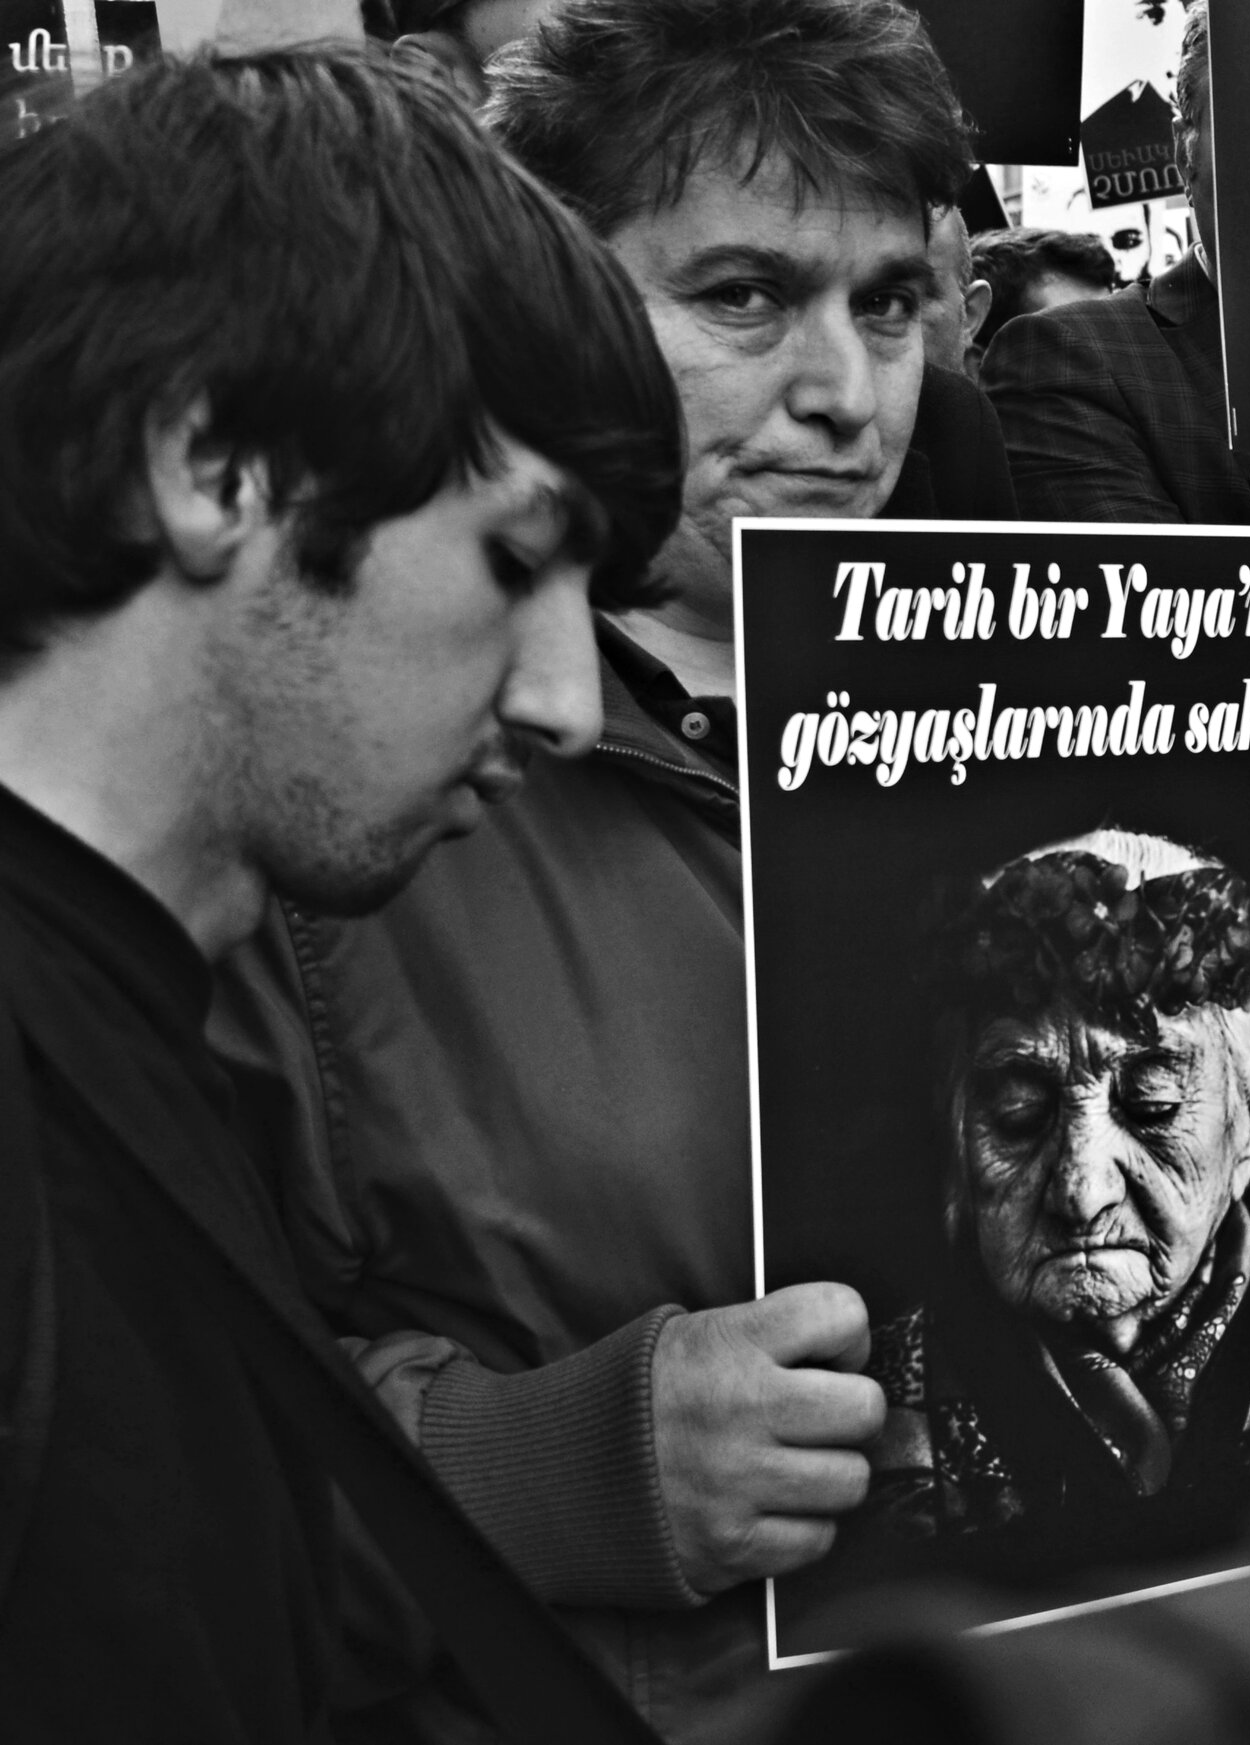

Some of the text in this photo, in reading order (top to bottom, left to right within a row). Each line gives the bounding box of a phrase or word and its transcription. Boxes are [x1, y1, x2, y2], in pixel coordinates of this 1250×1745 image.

[832, 560, 998, 643] Tarih
[1007, 561, 1090, 641] bir
[776, 679, 1177, 793] gözyaşlarında
